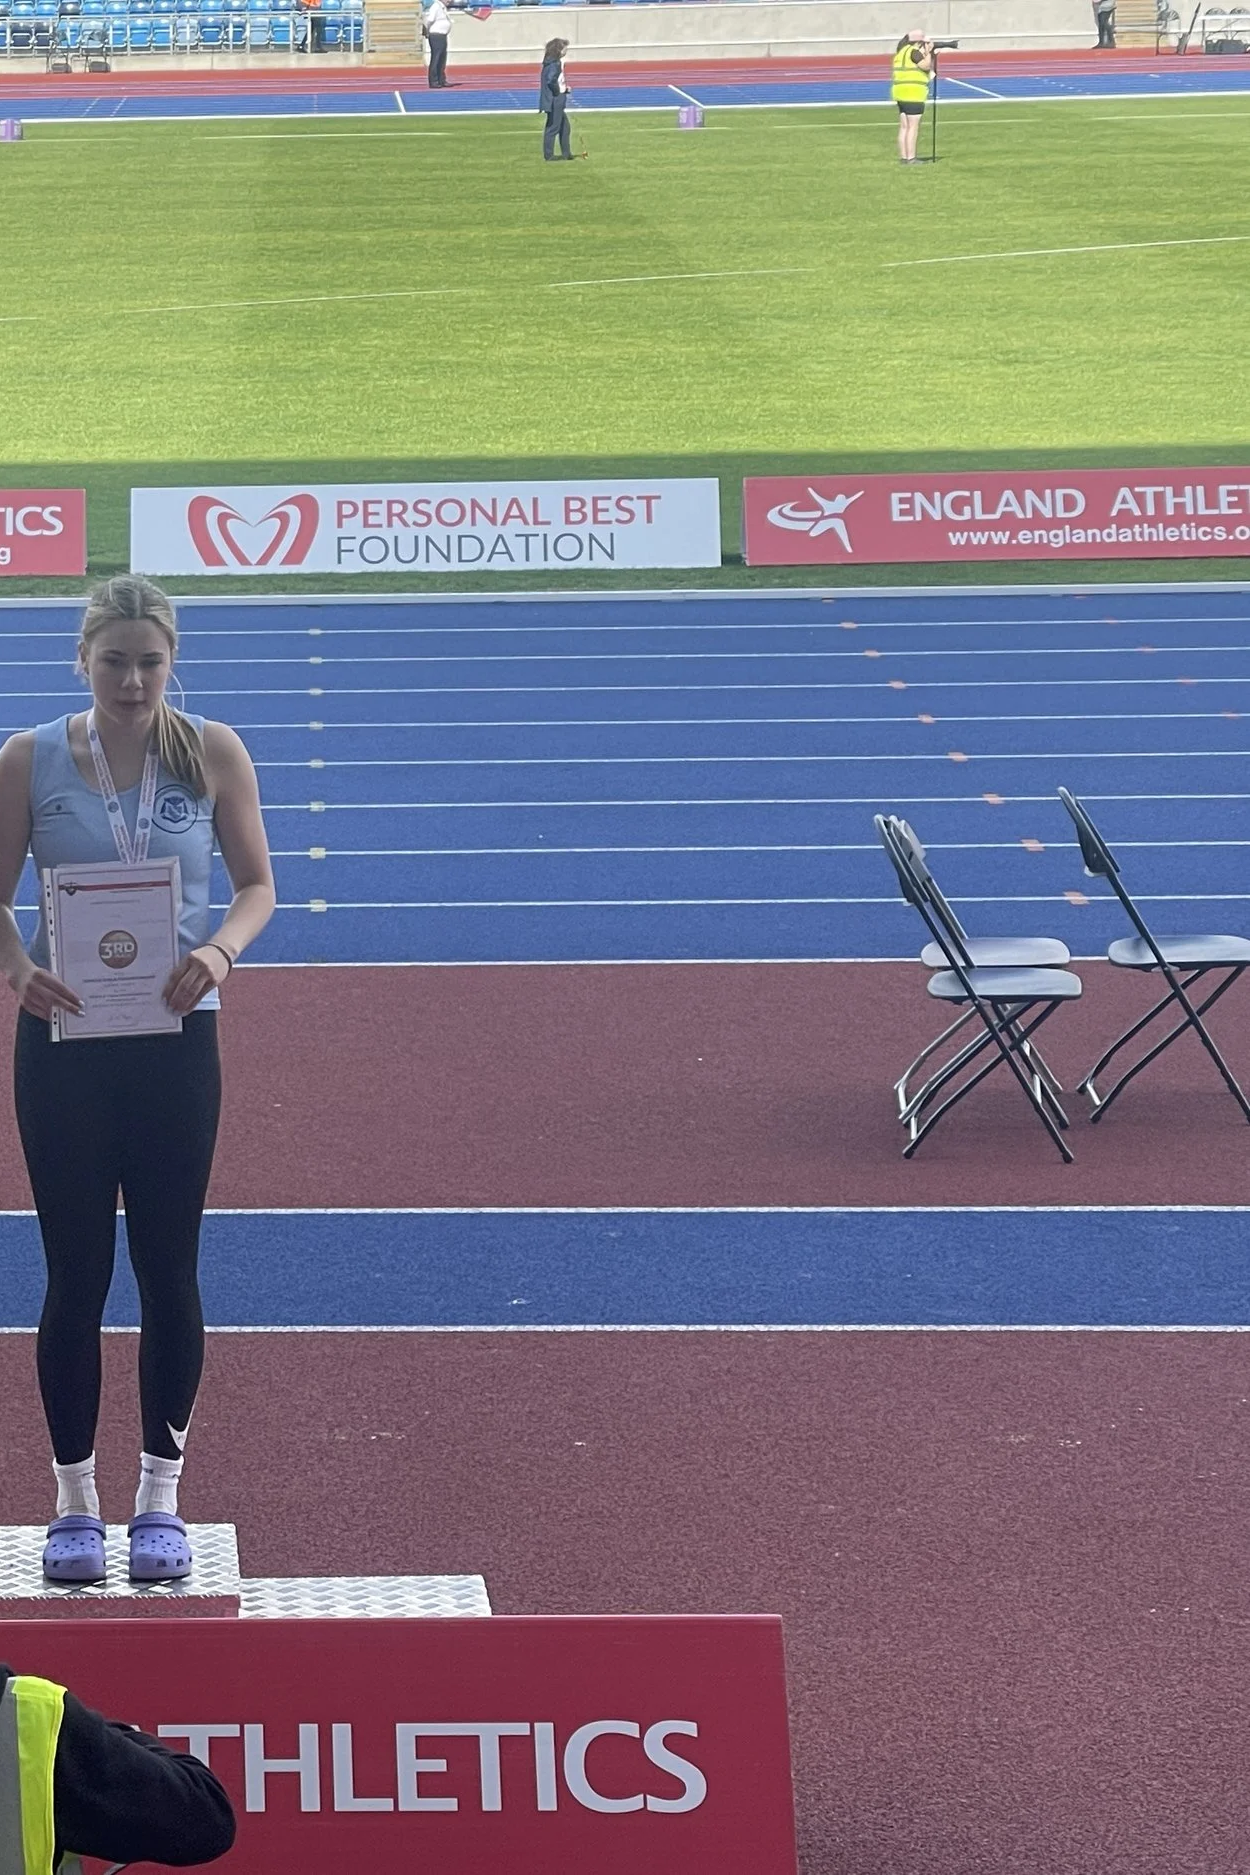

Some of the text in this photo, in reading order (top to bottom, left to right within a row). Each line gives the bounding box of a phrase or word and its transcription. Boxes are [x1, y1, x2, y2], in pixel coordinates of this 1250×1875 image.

[336, 494, 661, 529] PERSONAL BEST
[891, 487, 1086, 522] ENGLAND
[336, 532, 616, 565] FOUNDATION
[948, 522, 1250, 548] www.englandathletics.o
[100, 941, 135, 959] 3RD
[130, 1719, 708, 1814] THLETICS
